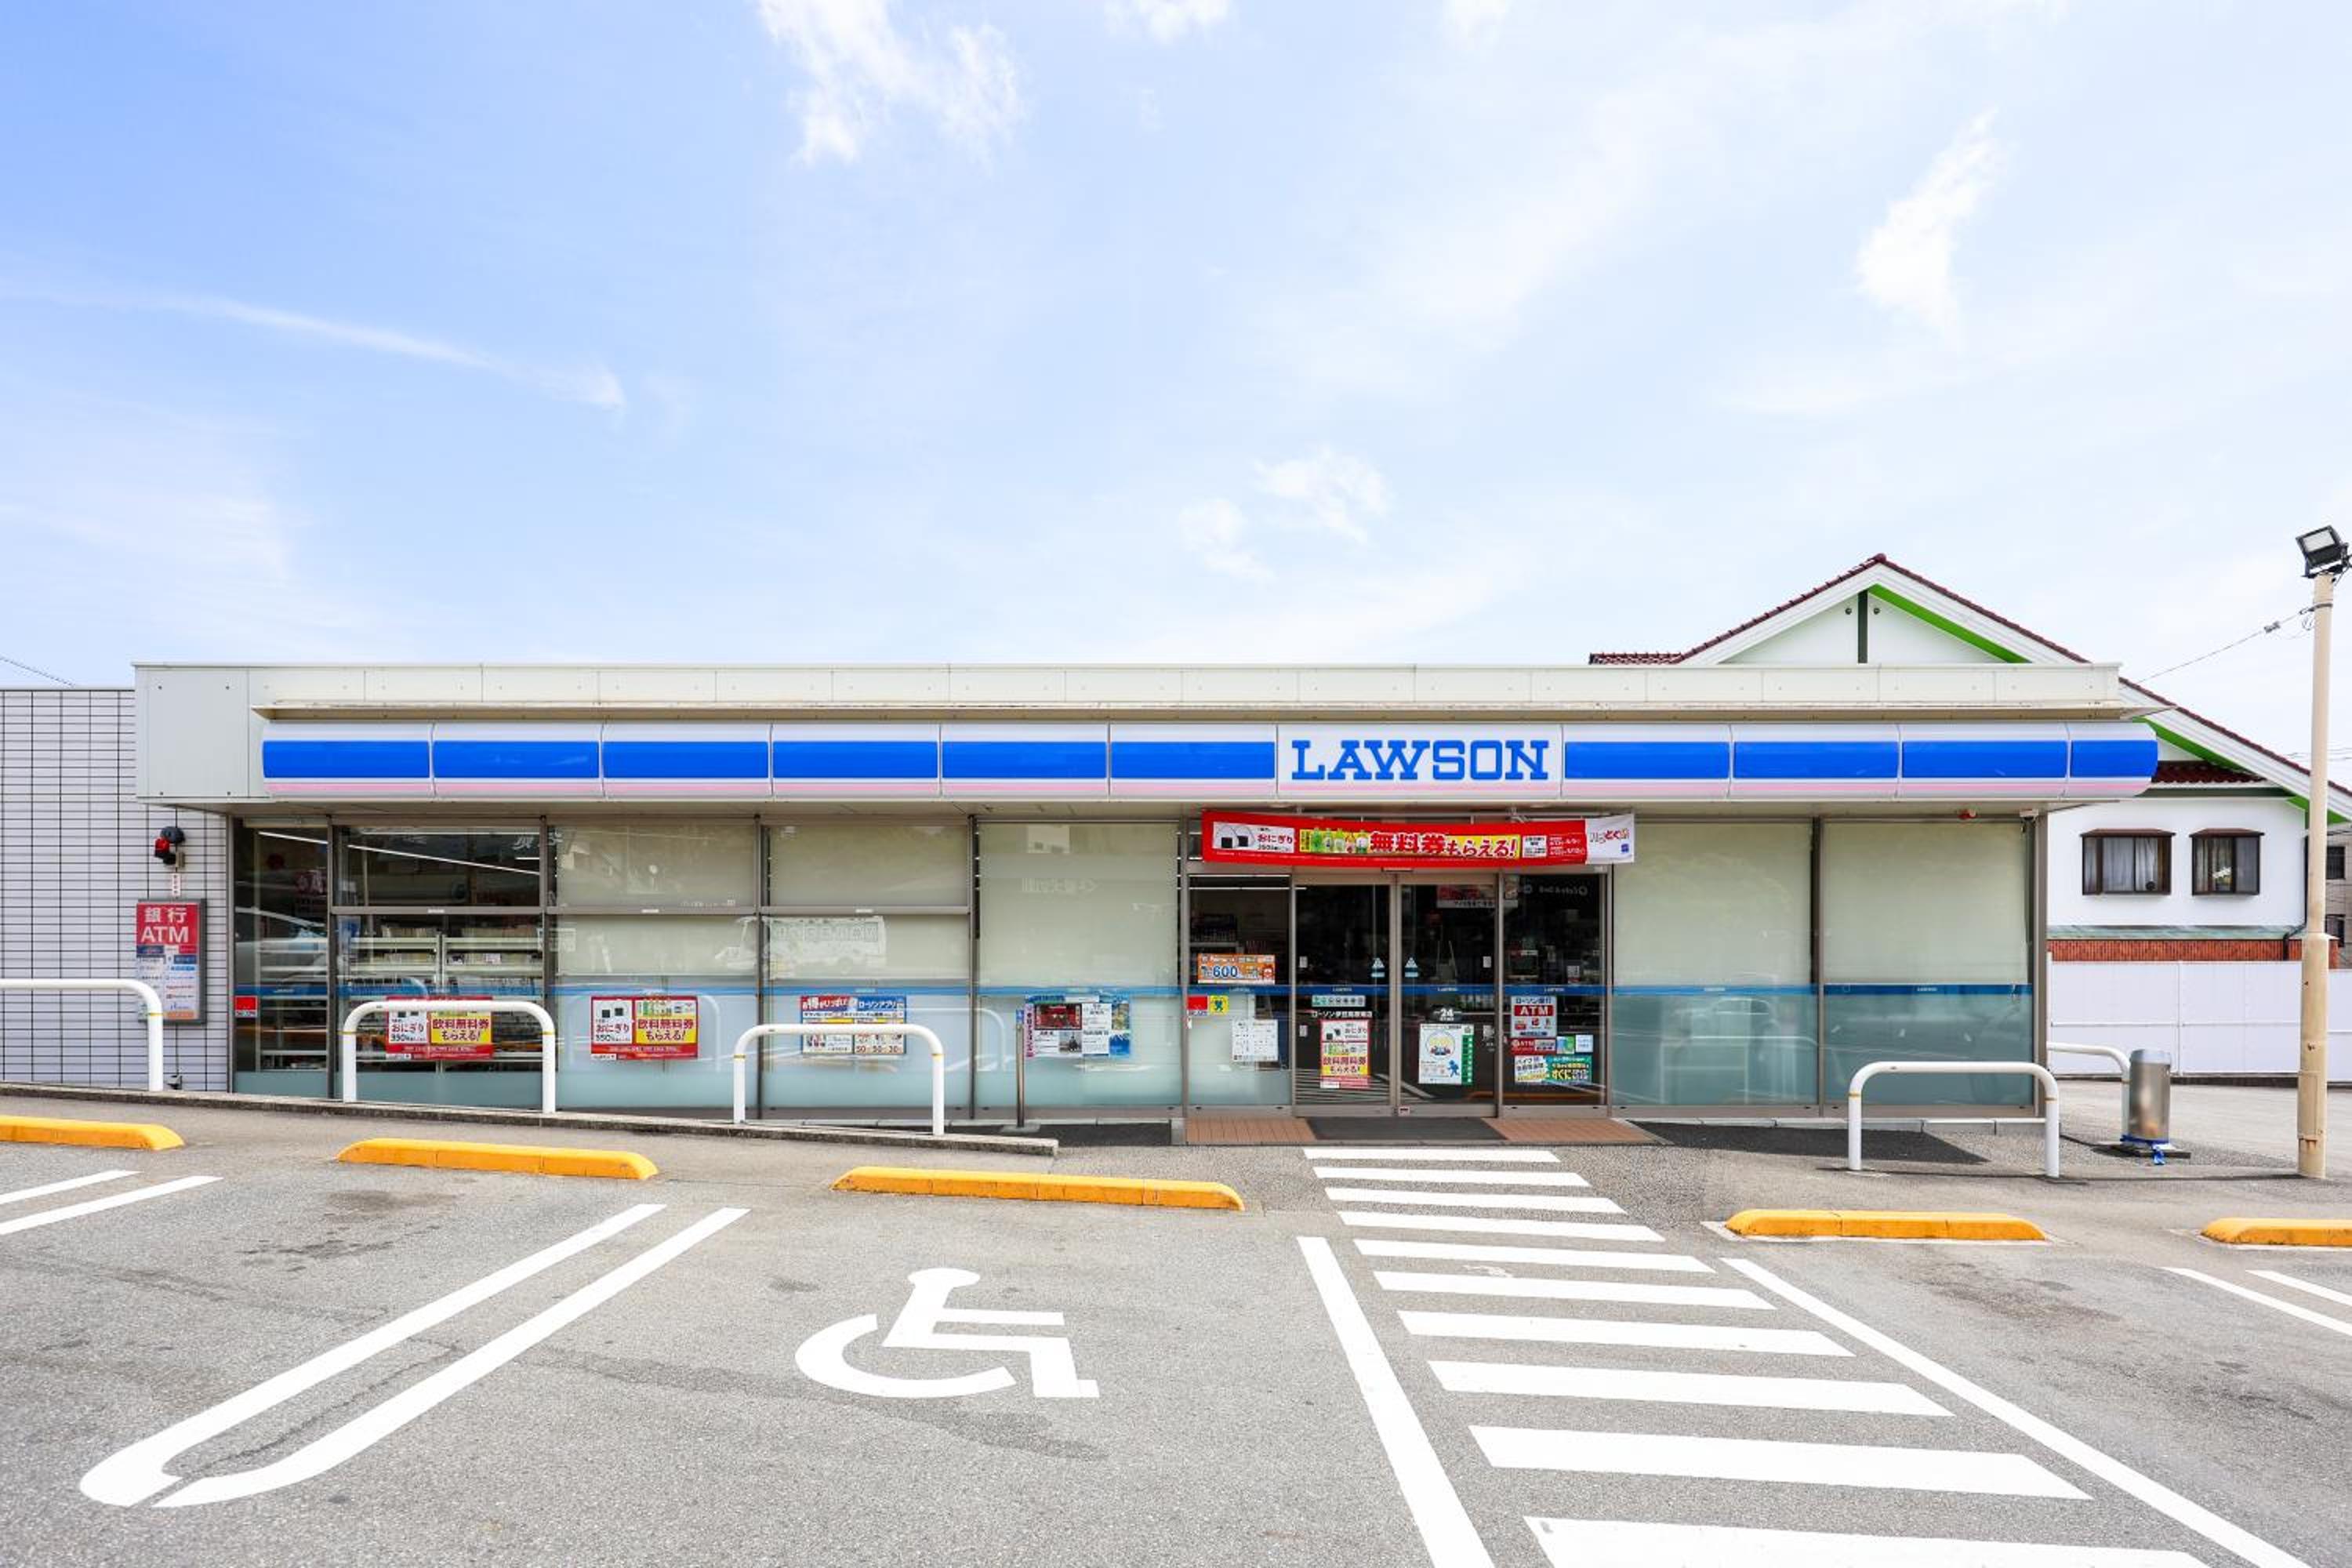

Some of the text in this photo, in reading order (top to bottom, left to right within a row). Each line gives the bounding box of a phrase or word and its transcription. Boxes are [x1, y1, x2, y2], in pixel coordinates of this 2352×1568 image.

[1291, 739, 1550, 781] LAWSON
[1257, 833, 1294, 844] おにぎり
[144, 907, 187, 924] 銀行
[141, 926, 189, 943] ATM
[1213, 965, 1238, 978] 600
[1440, 1008, 1454, 1017] 24
[1520, 1007, 1549, 1016] ATM
[391, 1022, 424, 1033] おにぎり
[596, 1023, 630, 1033] おにぎり
